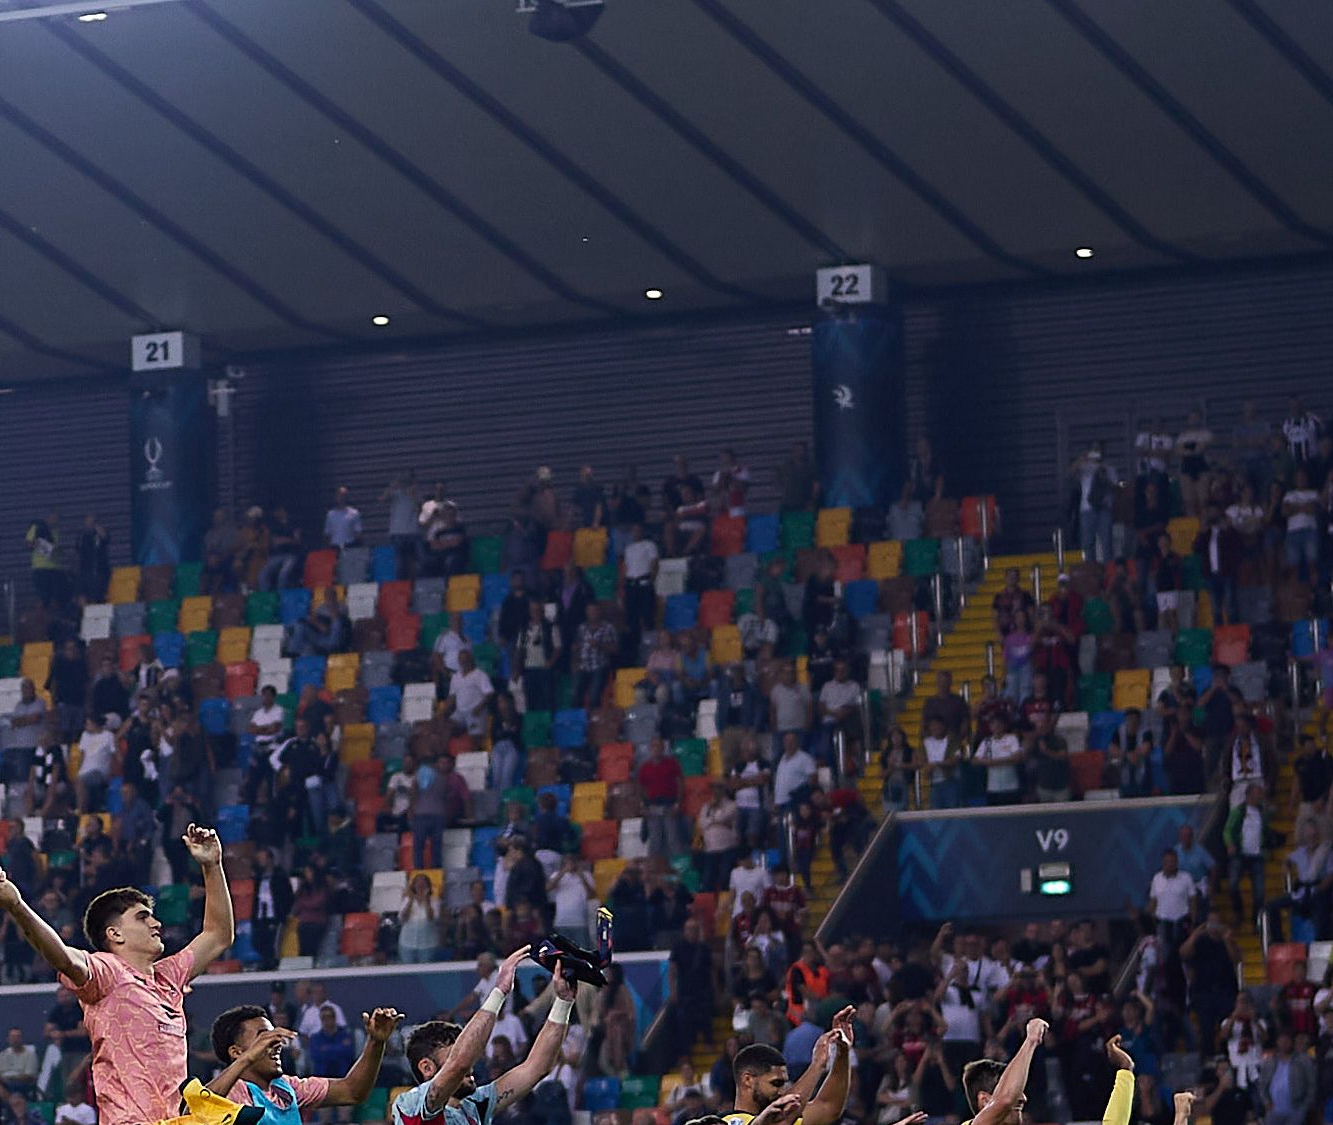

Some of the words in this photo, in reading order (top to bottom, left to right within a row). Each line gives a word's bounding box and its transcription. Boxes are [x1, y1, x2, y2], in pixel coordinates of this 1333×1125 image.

[829, 275, 860, 297] 22
[145, 341, 170, 362] 21
[1035, 829, 1069, 851] V9
